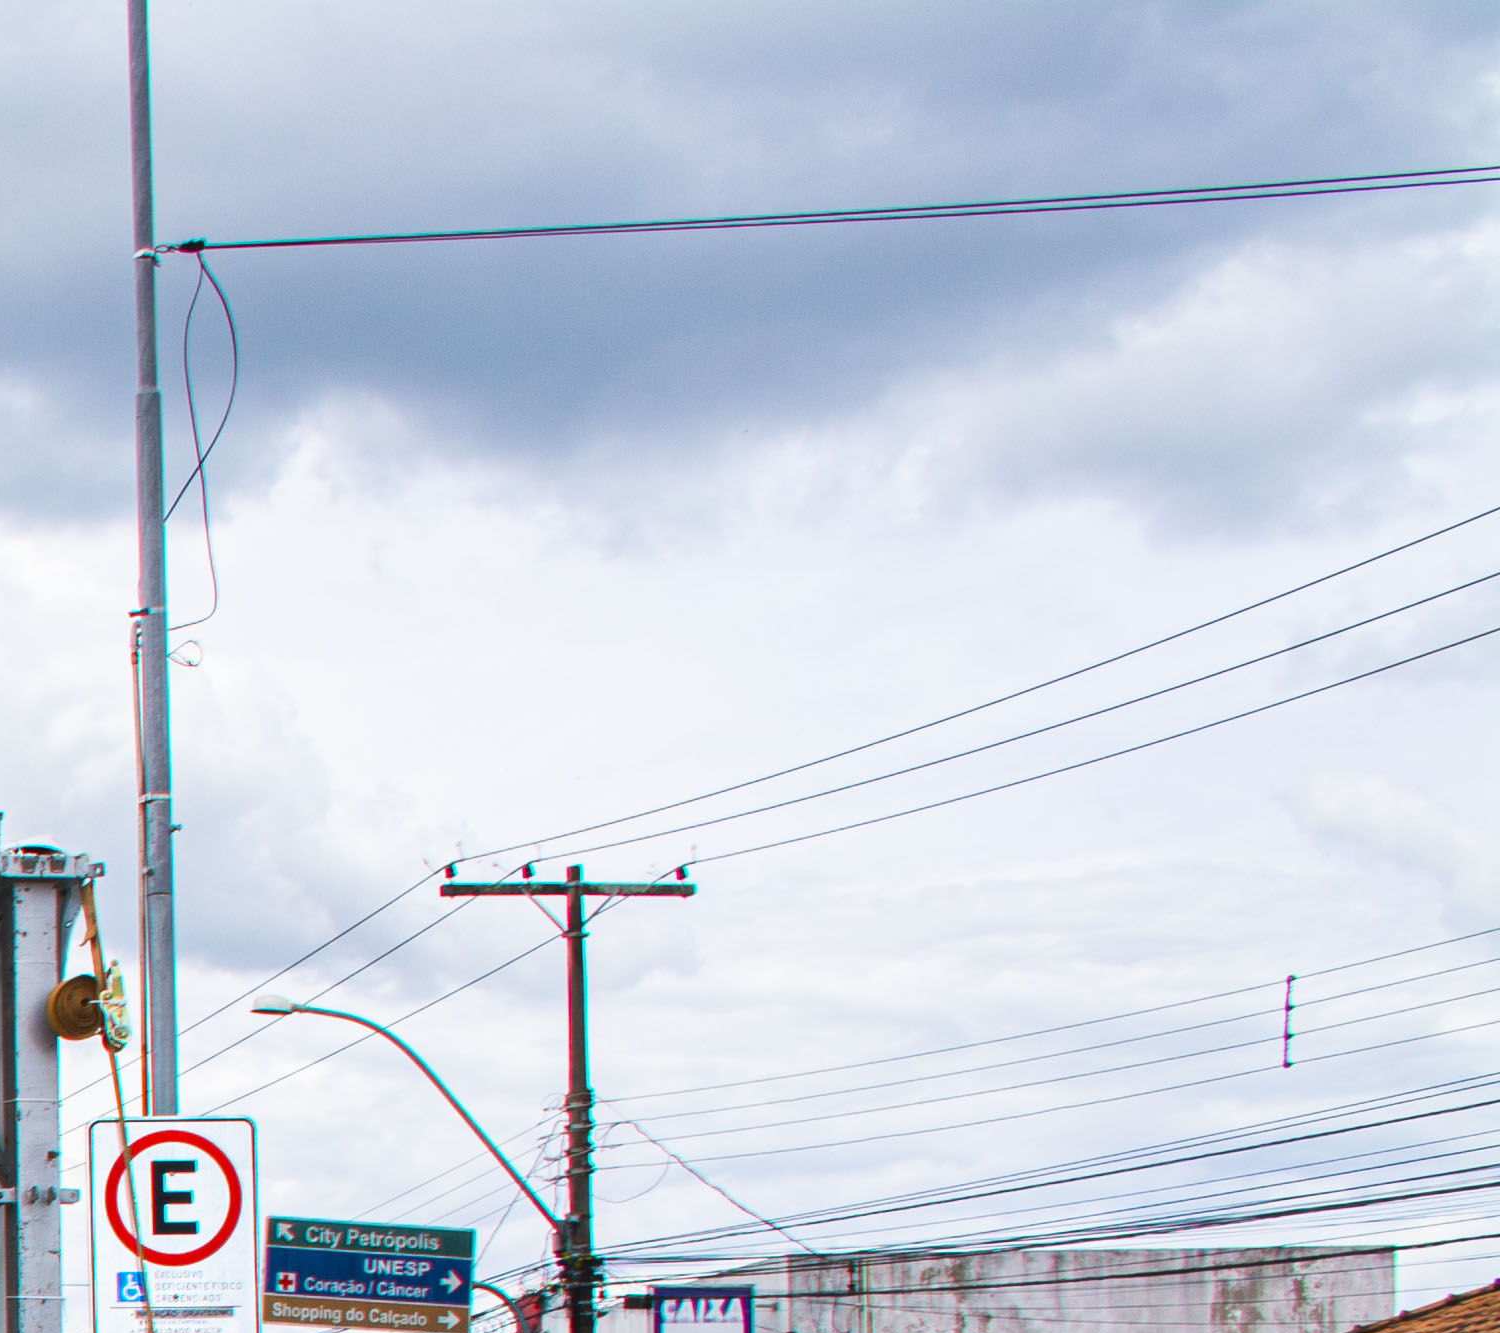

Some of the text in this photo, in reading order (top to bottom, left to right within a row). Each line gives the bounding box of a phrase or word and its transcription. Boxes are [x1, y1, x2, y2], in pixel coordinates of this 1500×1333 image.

[151, 1160, 199, 1235] E
[305, 1225, 440, 1252] City Petrópolis
[154, 1270, 204, 1279] EXCLUSIVO
[363, 1257, 433, 1277] UNESP
[154, 1281, 210, 1291] DEFICIENTE
[303, 1276, 365, 1297] Coração
[376, 1281, 430, 1299] Câncer
[272, 1302, 428, 1328] Shopping do Calçado
[661, 1297, 745, 1323] CAIXA
